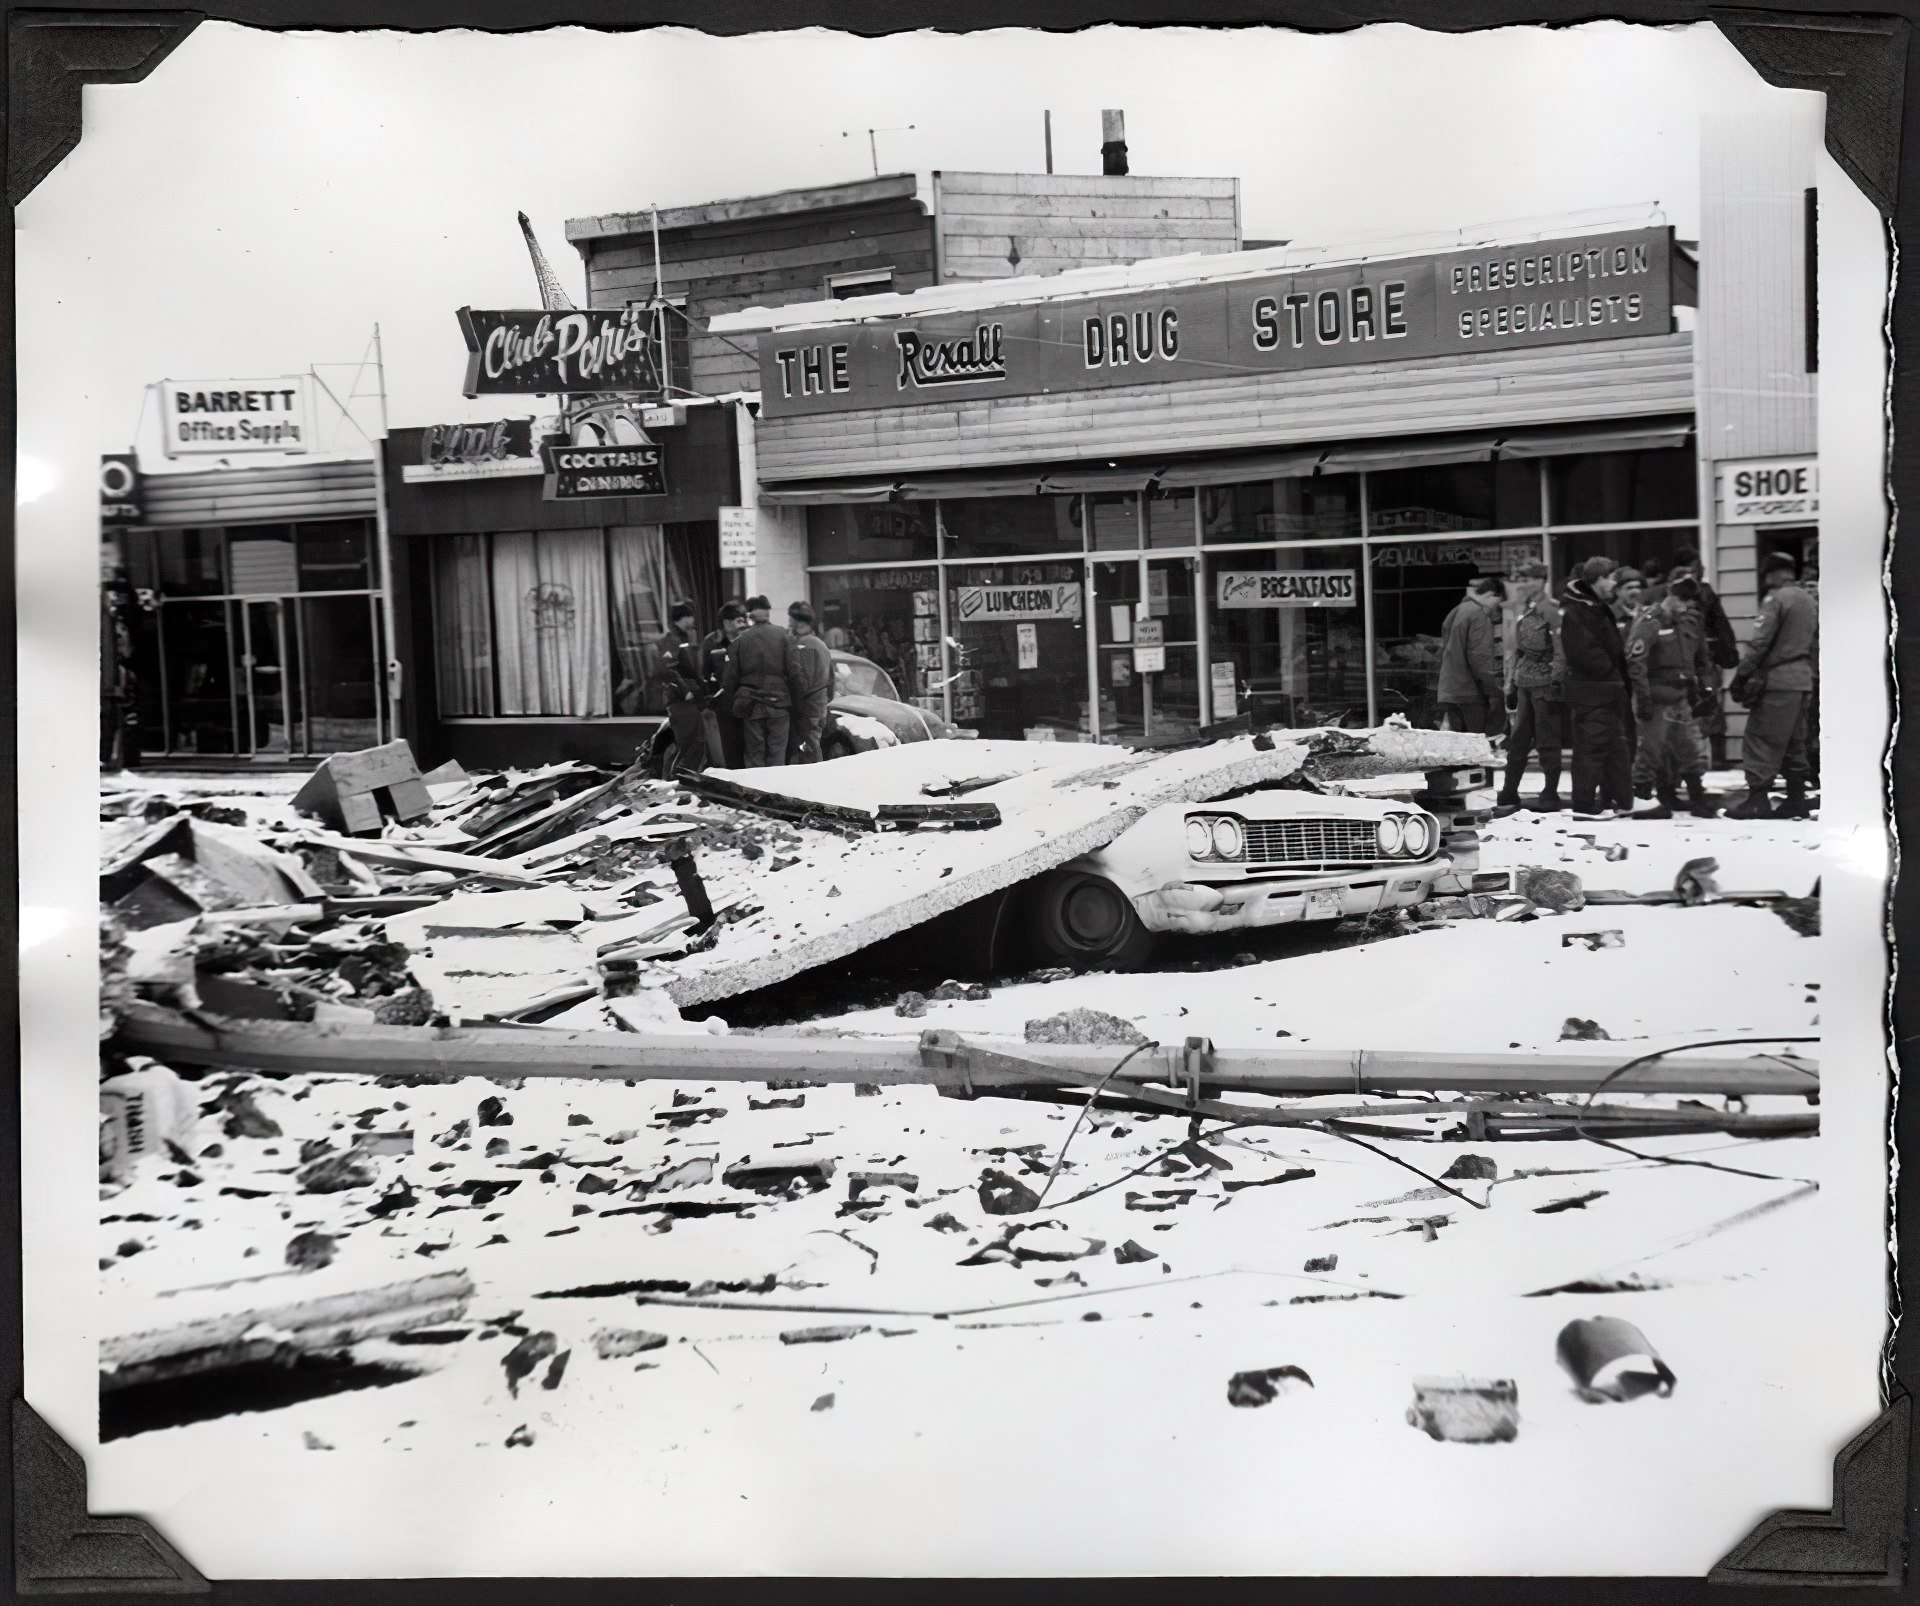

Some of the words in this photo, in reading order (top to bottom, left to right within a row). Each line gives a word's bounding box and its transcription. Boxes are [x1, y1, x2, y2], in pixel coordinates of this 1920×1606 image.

[1450, 244, 1649, 294] PRESCRIPTION
[1458, 294, 1644, 339] SPECIALISTS
[484, 314, 554, 379] Club
[550, 308, 648, 385] Paris
[775, 343, 850, 398] THE
[894, 322, 1005, 391] Rexall
[1083, 306, 1182, 370] DRUG
[1252, 280, 1408, 352] STORE
[176, 389, 296, 414] BARRETT
[178, 420, 236, 442] Office
[239, 418, 300, 444] Supply
[559, 450, 659, 470] COCKTAILS
[576, 474, 645, 492] DINING
[1734, 467, 1809, 498] SHOE
[1259, 574, 1353, 600] BREAKFASTS
[985, 588, 1053, 613] LUNCHEON
